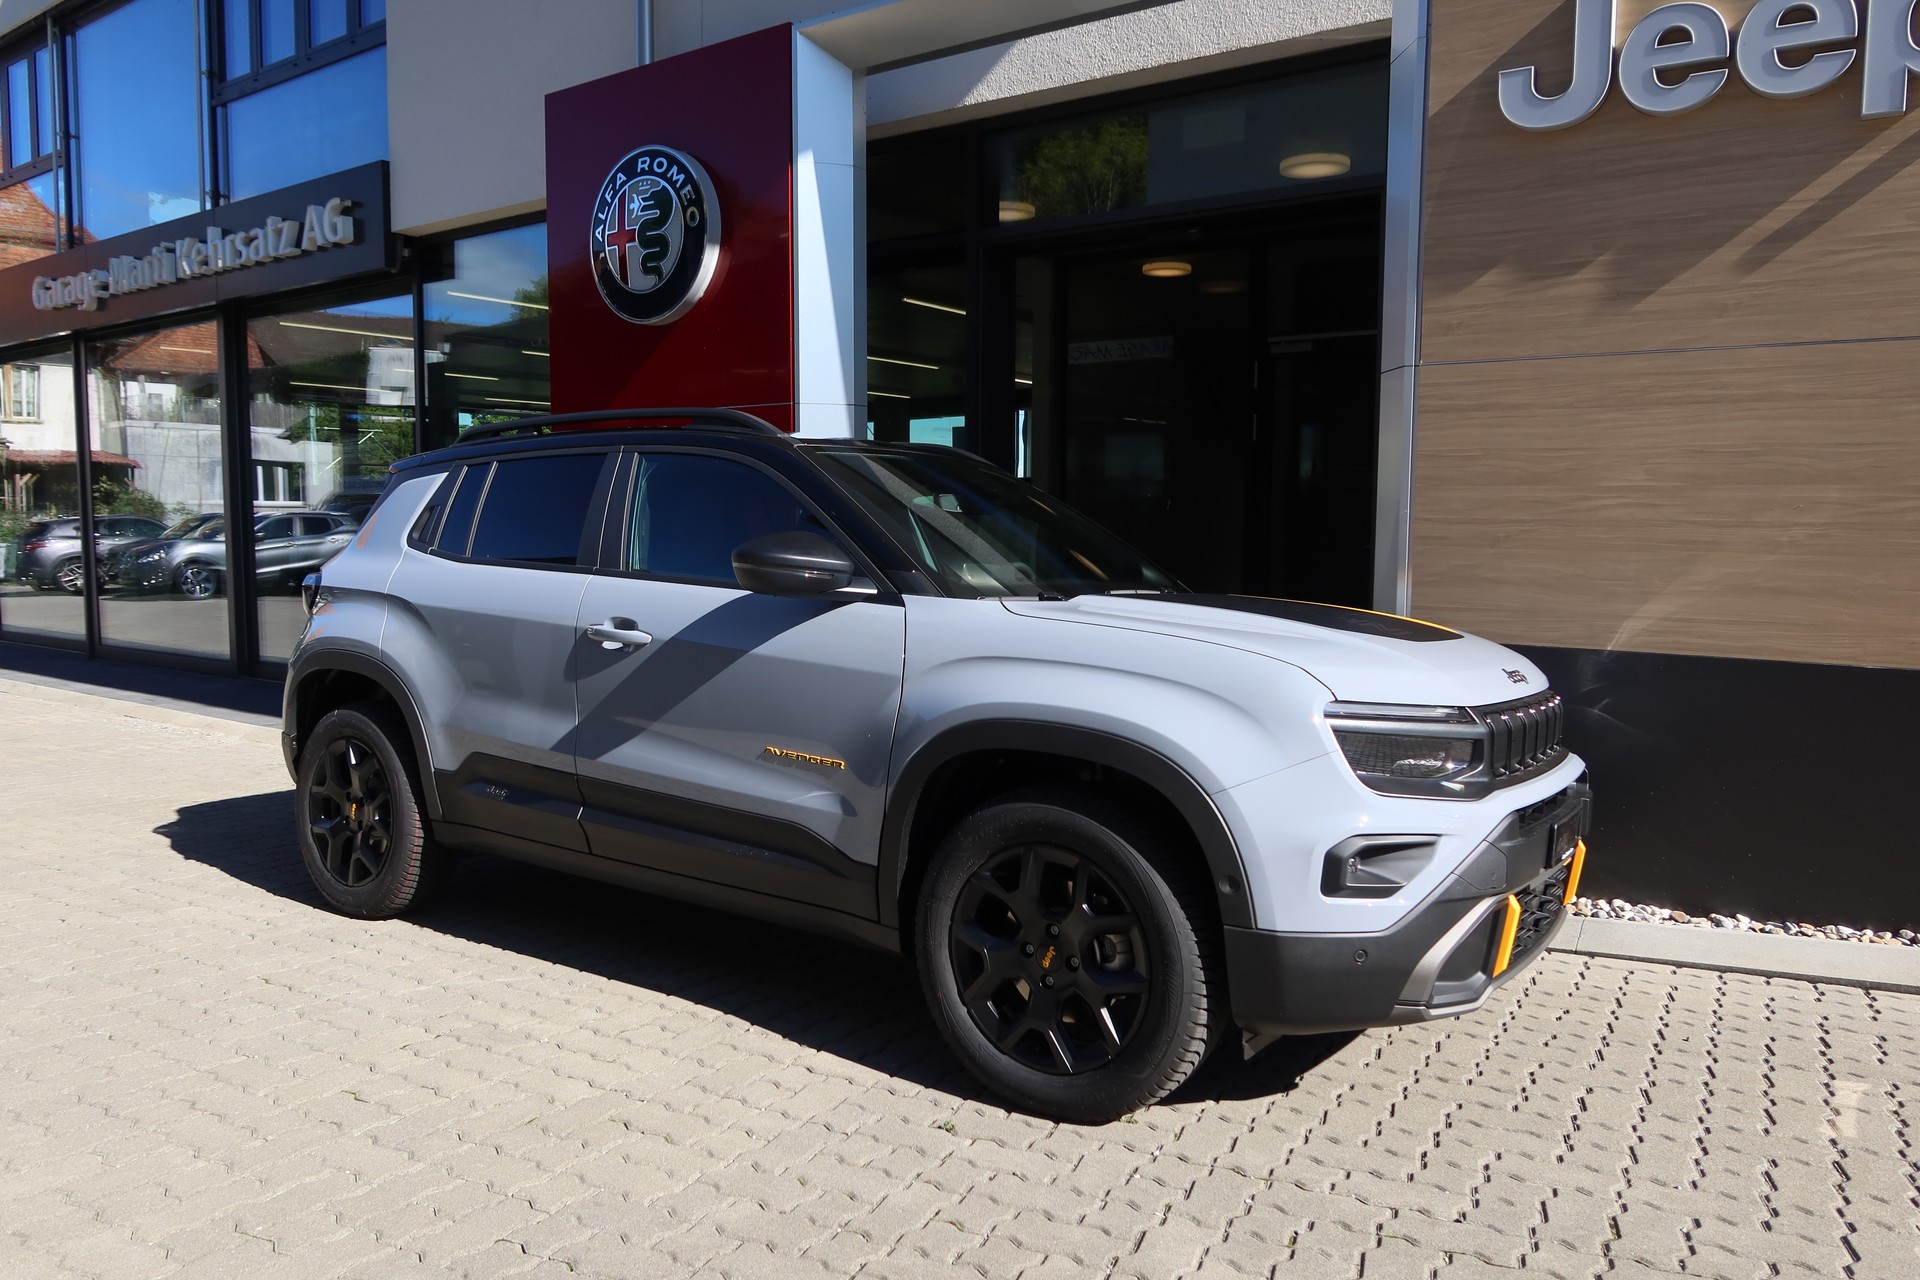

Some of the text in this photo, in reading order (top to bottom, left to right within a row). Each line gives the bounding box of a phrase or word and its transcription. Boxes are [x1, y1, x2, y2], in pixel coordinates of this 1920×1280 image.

[595, 157, 700, 242] ALFA ROMEO
[32, 269, 110, 312] Garage
[175, 215, 301, 279] Kehrsatz
[301, 197, 355, 251] AG
[764, 746, 845, 770] AVENGER
[1042, 945, 1056, 969] Jeep
